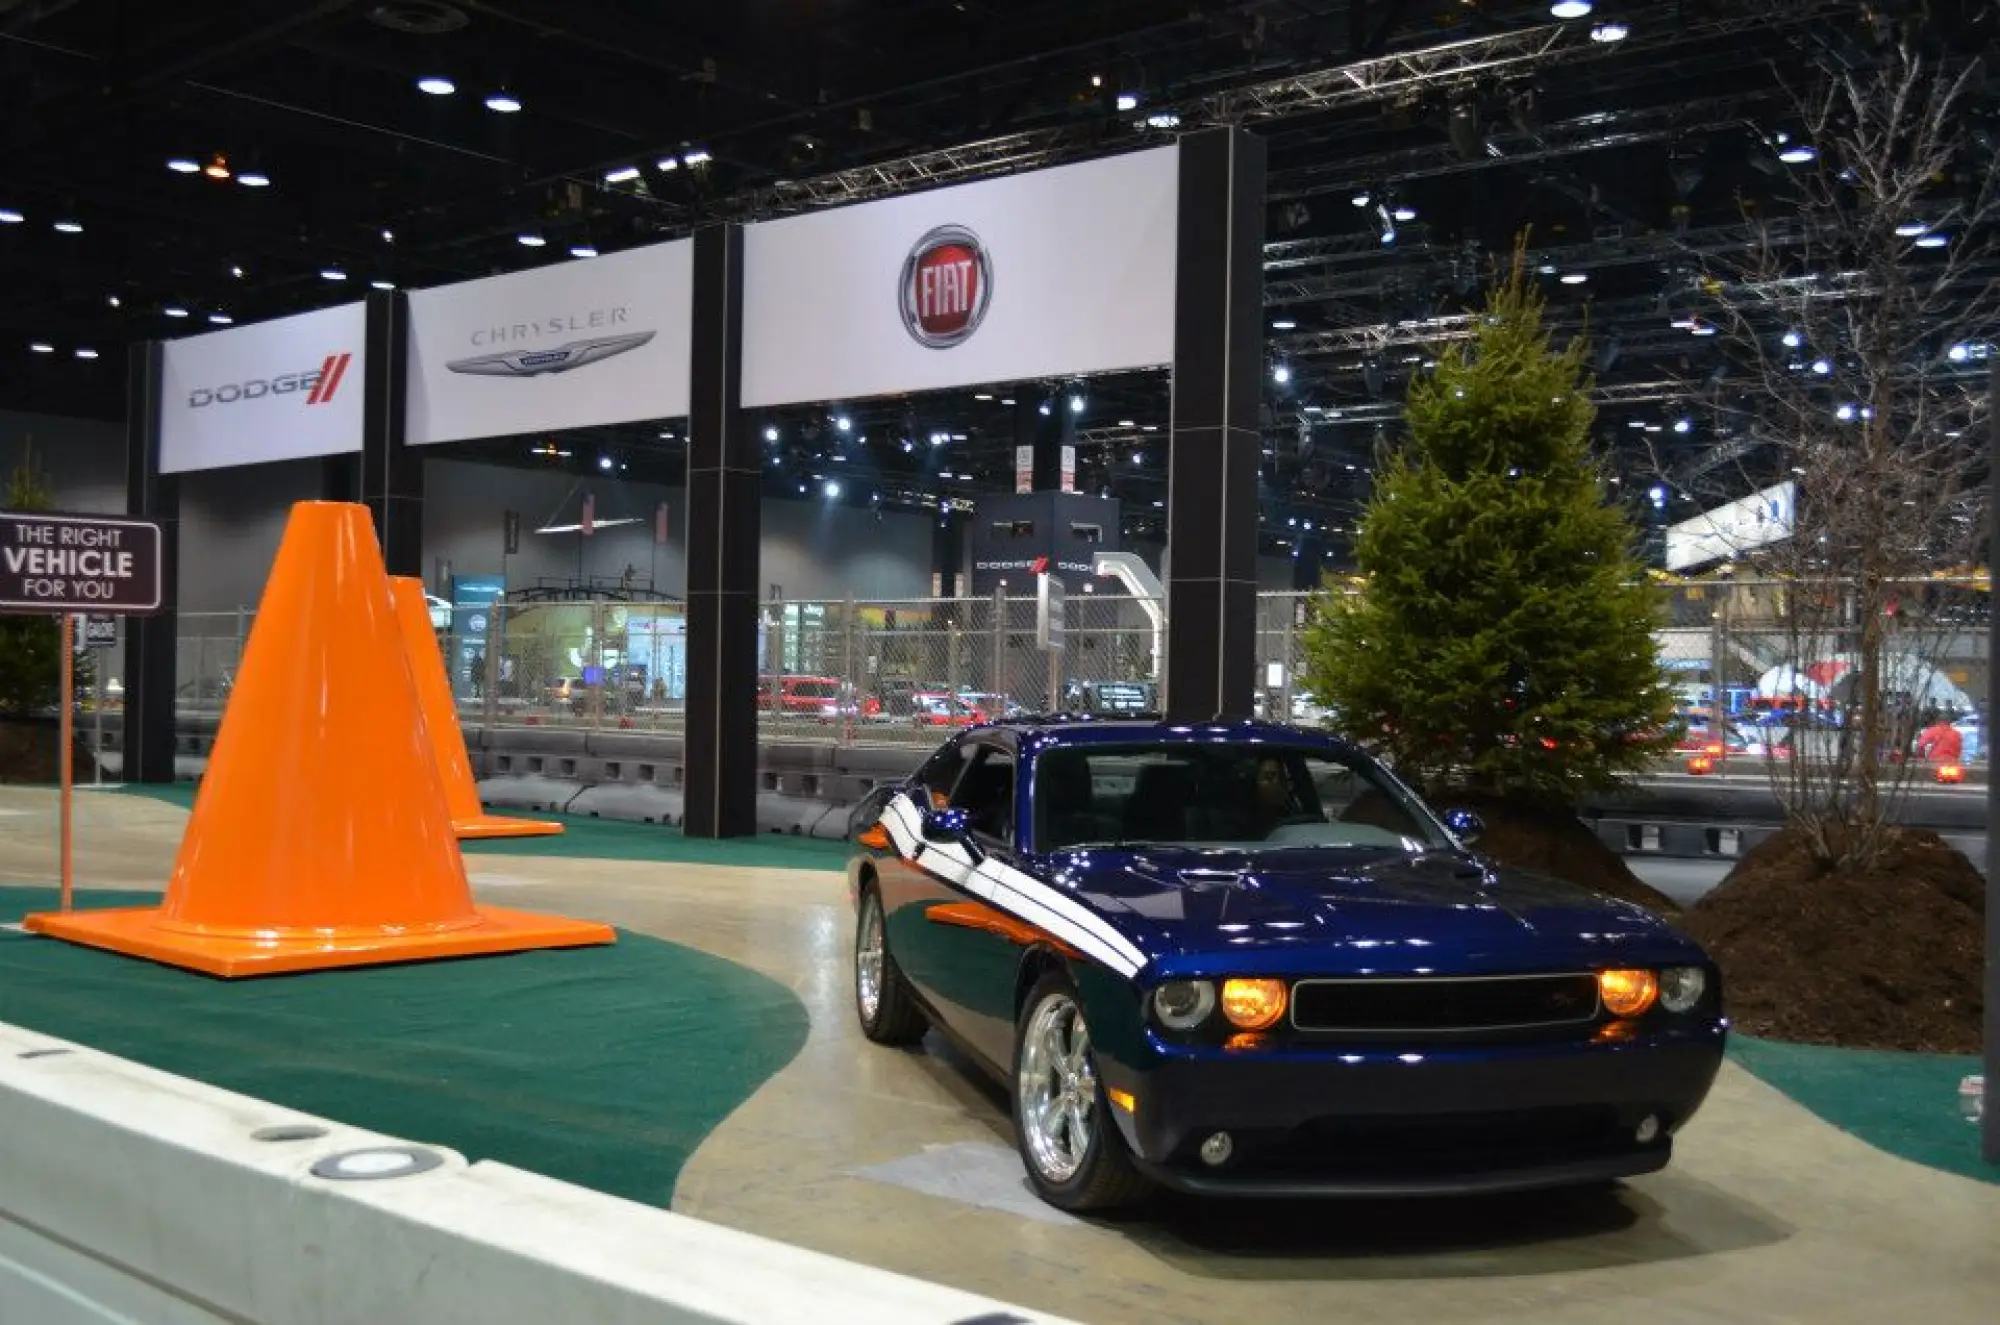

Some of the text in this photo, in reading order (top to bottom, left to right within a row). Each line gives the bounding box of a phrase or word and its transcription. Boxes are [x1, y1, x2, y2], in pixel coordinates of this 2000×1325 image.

[921, 260, 973, 317] FIAT
[472, 308, 629, 346] CHRYSLER
[189, 370, 322, 408] DODGE
[16, 525, 122, 547] THE RIGHT
[5, 547, 133, 578] VEHICLE
[24, 578, 115, 599] FOR YOU
